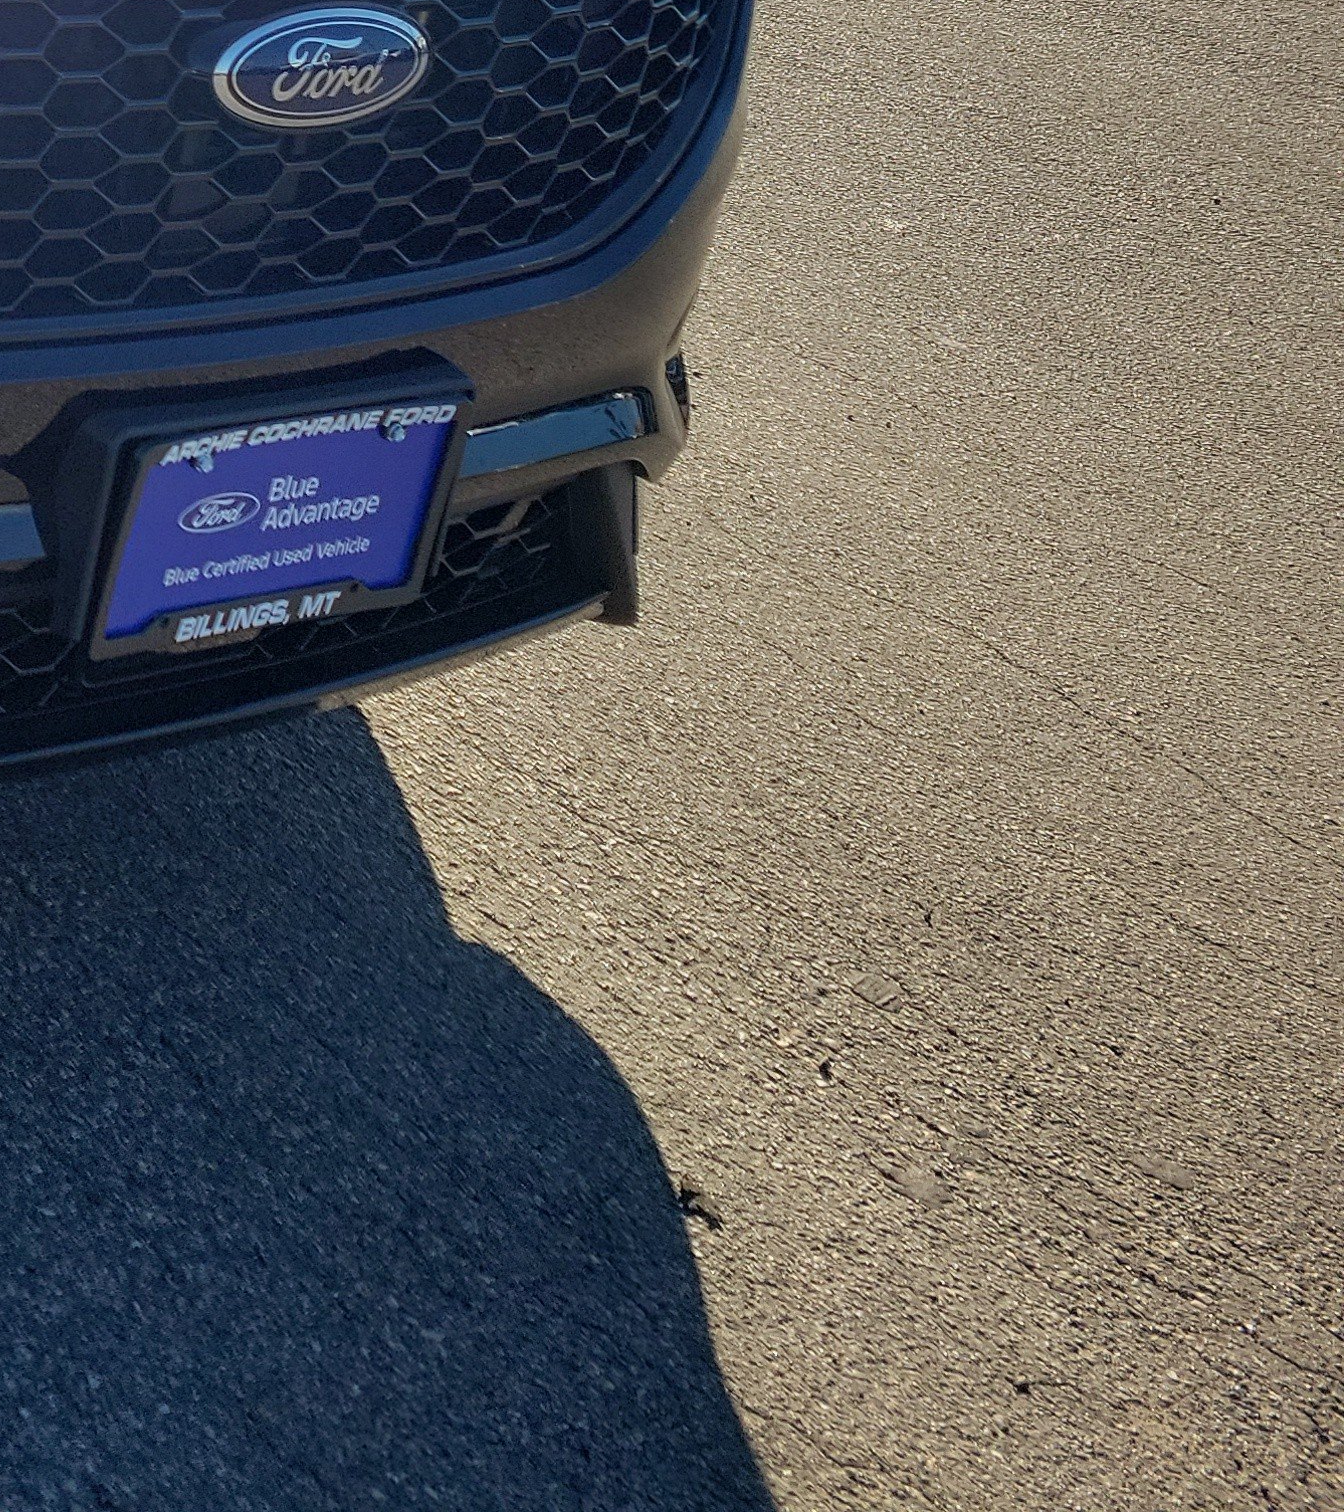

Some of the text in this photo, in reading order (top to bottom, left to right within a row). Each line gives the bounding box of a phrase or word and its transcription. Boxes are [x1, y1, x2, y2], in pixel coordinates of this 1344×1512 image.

[272, 37, 391, 102] Ford
[159, 405, 457, 466] ARCHIE COCHRANE FORD
[192, 498, 246, 528] Ford
[260, 495, 381, 531] Advantage
[269, 475, 320, 503] Blue
[163, 534, 371, 587] Blue Certified Used Vehicle
[175, 590, 342, 643] BILLINGS, MT
